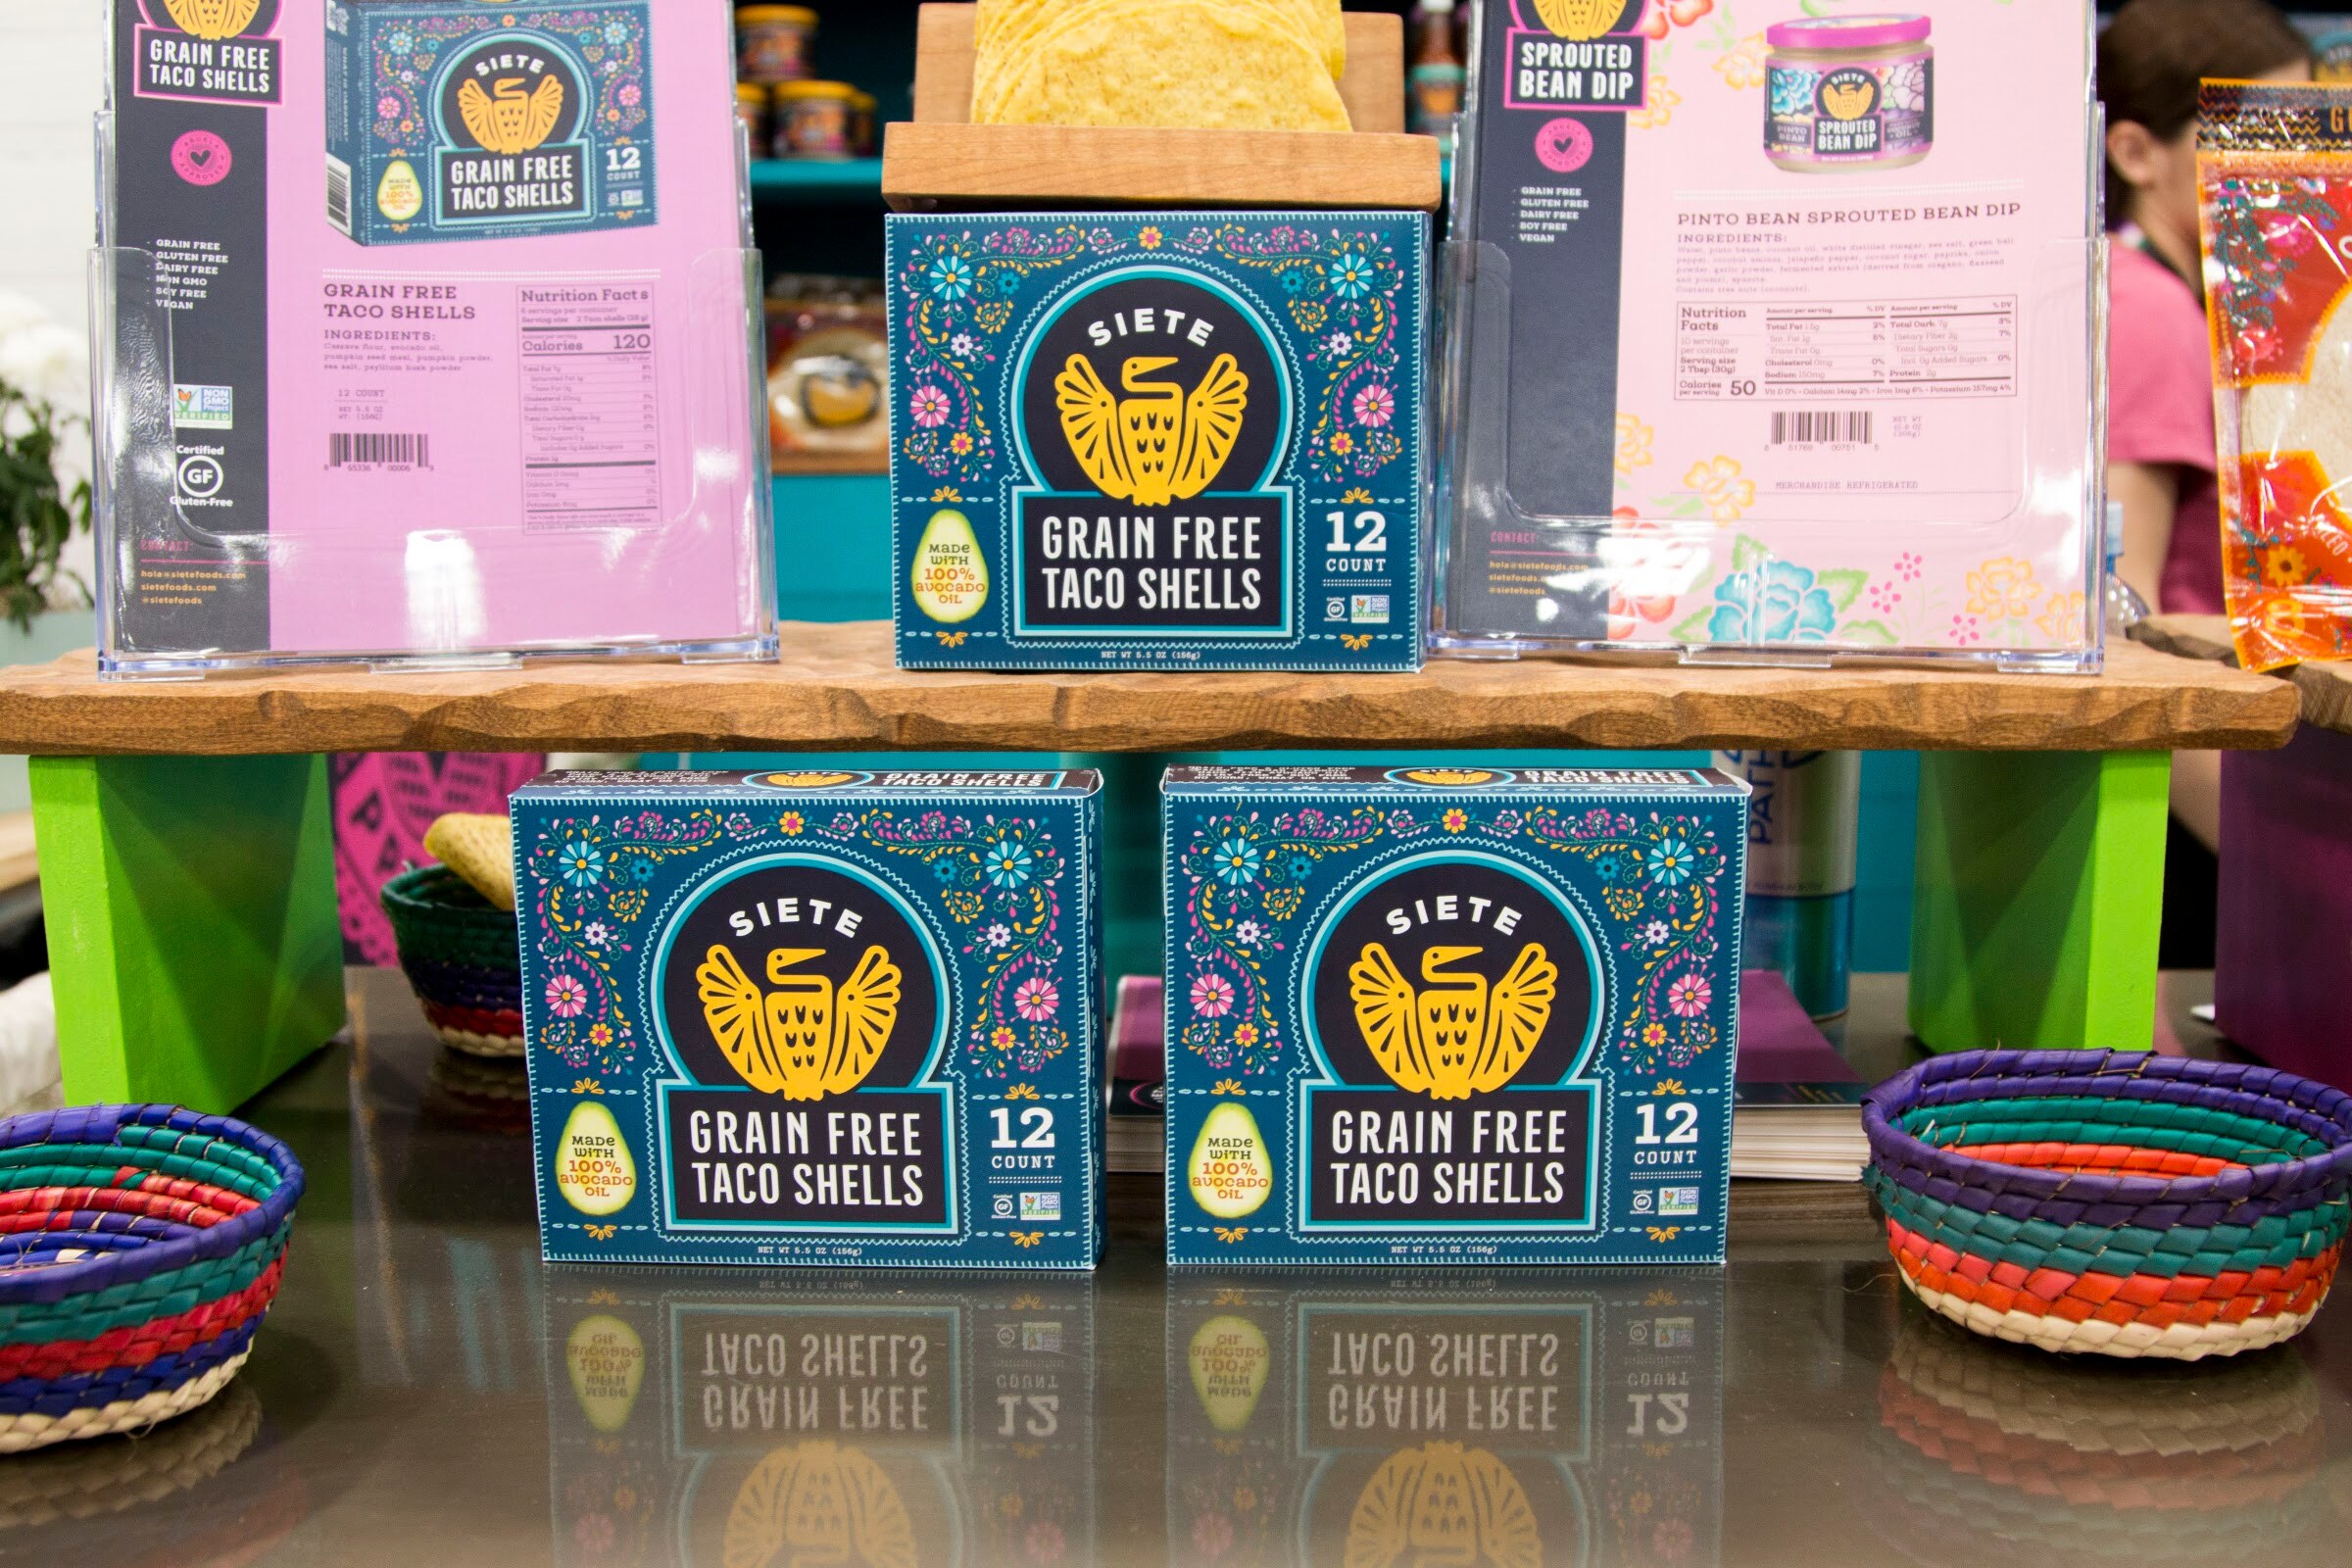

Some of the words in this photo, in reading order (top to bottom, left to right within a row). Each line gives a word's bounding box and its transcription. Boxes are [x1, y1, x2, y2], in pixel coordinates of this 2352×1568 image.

[149, 39, 213, 68] GRAIN
[220, 45, 270, 71] FREE
[1521, 41, 1633, 69] SPROUTED
[475, 54, 546, 76] SIETE
[150, 64, 196, 87] TACO
[202, 67, 270, 93] SHELLS
[1519, 69, 1582, 99] BEAN
[1592, 71, 1634, 100] DIP
[1818, 119, 1877, 134] SPROUTED
[1818, 134, 1851, 150] BEAN
[1856, 132, 1878, 149] DIP
[606, 146, 641, 172] 12
[451, 158, 514, 185] GRAIN
[522, 155, 573, 181] FREE
[607, 171, 640, 181] COUNT
[451, 185, 499, 211] TACO
[504, 181, 574, 209] SHELLS
[1521, 186, 1553, 195] GRAIN
[1556, 187, 1582, 196] FREE
[1520, 198, 1561, 208] GLUTEN
[1563, 199, 1590, 209] FREE
[1520, 210, 1551, 219] DAIRY
[1553, 211, 1579, 220] FREE
[1678, 213, 1739, 225] PINTO
[1745, 212, 1801, 225] BEAN
[1807, 208, 1917, 224] SPROUTED
[1923, 205, 1980, 220] BEAN
[1985, 202, 2021, 217] DIP
[1519, 221, 1540, 230] SOY
[1542, 221, 1568, 231] FREE
[156, 239, 190, 249] GRAIN
[193, 241, 220, 251] FREE
[1519, 233, 1554, 243] VEGAN
[1678, 232, 1788, 243] INGREDIENTS:
[156, 251, 199, 262] GLUTEN
[202, 253, 228, 264] FREE
[155, 262, 189, 273] DAIRY
[191, 265, 219, 275] FREE
[182, 277, 208, 286] GMO
[179, 289, 207, 298] FREE
[323, 283, 395, 299] GRAIN
[402, 285, 457, 299] FREE
[521, 288, 598, 303] Nutrition
[603, 288, 649, 301] Facts
[155, 299, 194, 310] VEGAN
[323, 303, 384, 318] TACO
[391, 305, 475, 319] SHELLS
[1681, 307, 1746, 318] Nutrition
[1088, 308, 1215, 347] SIETE
[1681, 320, 1719, 331] Facts
[324, 329, 436, 341] INGREDIENTS:
[613, 333, 651, 349] 120
[522, 340, 583, 352] Calories
[1680, 379, 1722, 389] Calories
[1730, 380, 1757, 396] 50
[203, 397, 229, 406] GMO
[174, 412, 229, 420] VERIFIED
[176, 444, 224, 456] Certified
[187, 468, 214, 484] GF
[169, 495, 233, 508] Gluten-Free
[1042, 515, 1155, 560] GRAIN
[1173, 515, 1262, 561] FREE
[1326, 511, 1387, 552] 12
[1491, 531, 1537, 544] CONTACT
[1326, 558, 1387, 572] COUNT
[924, 567, 975, 581] 100%
[1042, 566, 1124, 610] TACO
[1138, 566, 1262, 610] SHELLS
[1171, 651, 1201, 661] (156g)
[728, 896, 863, 939] SIETE
[1386, 894, 1524, 938] SIETE
[990, 1106, 1055, 1149] 12
[1332, 1108, 1453, 1154] GRAIN
[1473, 1108, 1567, 1154] FREE
[1635, 1102, 1698, 1145] 12
[690, 1108, 808, 1155] GRAIN
[828, 1110, 922, 1157] FREE
[991, 1154, 1055, 1169] COUNT
[1634, 1150, 1697, 1165] COUNT
[568, 1159, 622, 1174] 100%
[1202, 1161, 1257, 1176] 100%
[691, 1161, 780, 1205] TACO
[794, 1161, 924, 1207] SHELLS
[1331, 1160, 1419, 1204] TACO
[1433, 1159, 1564, 1204] SHELLS
[832, 1247, 862, 1256] (156g)
[1466, 1246, 1497, 1255] (156g)
